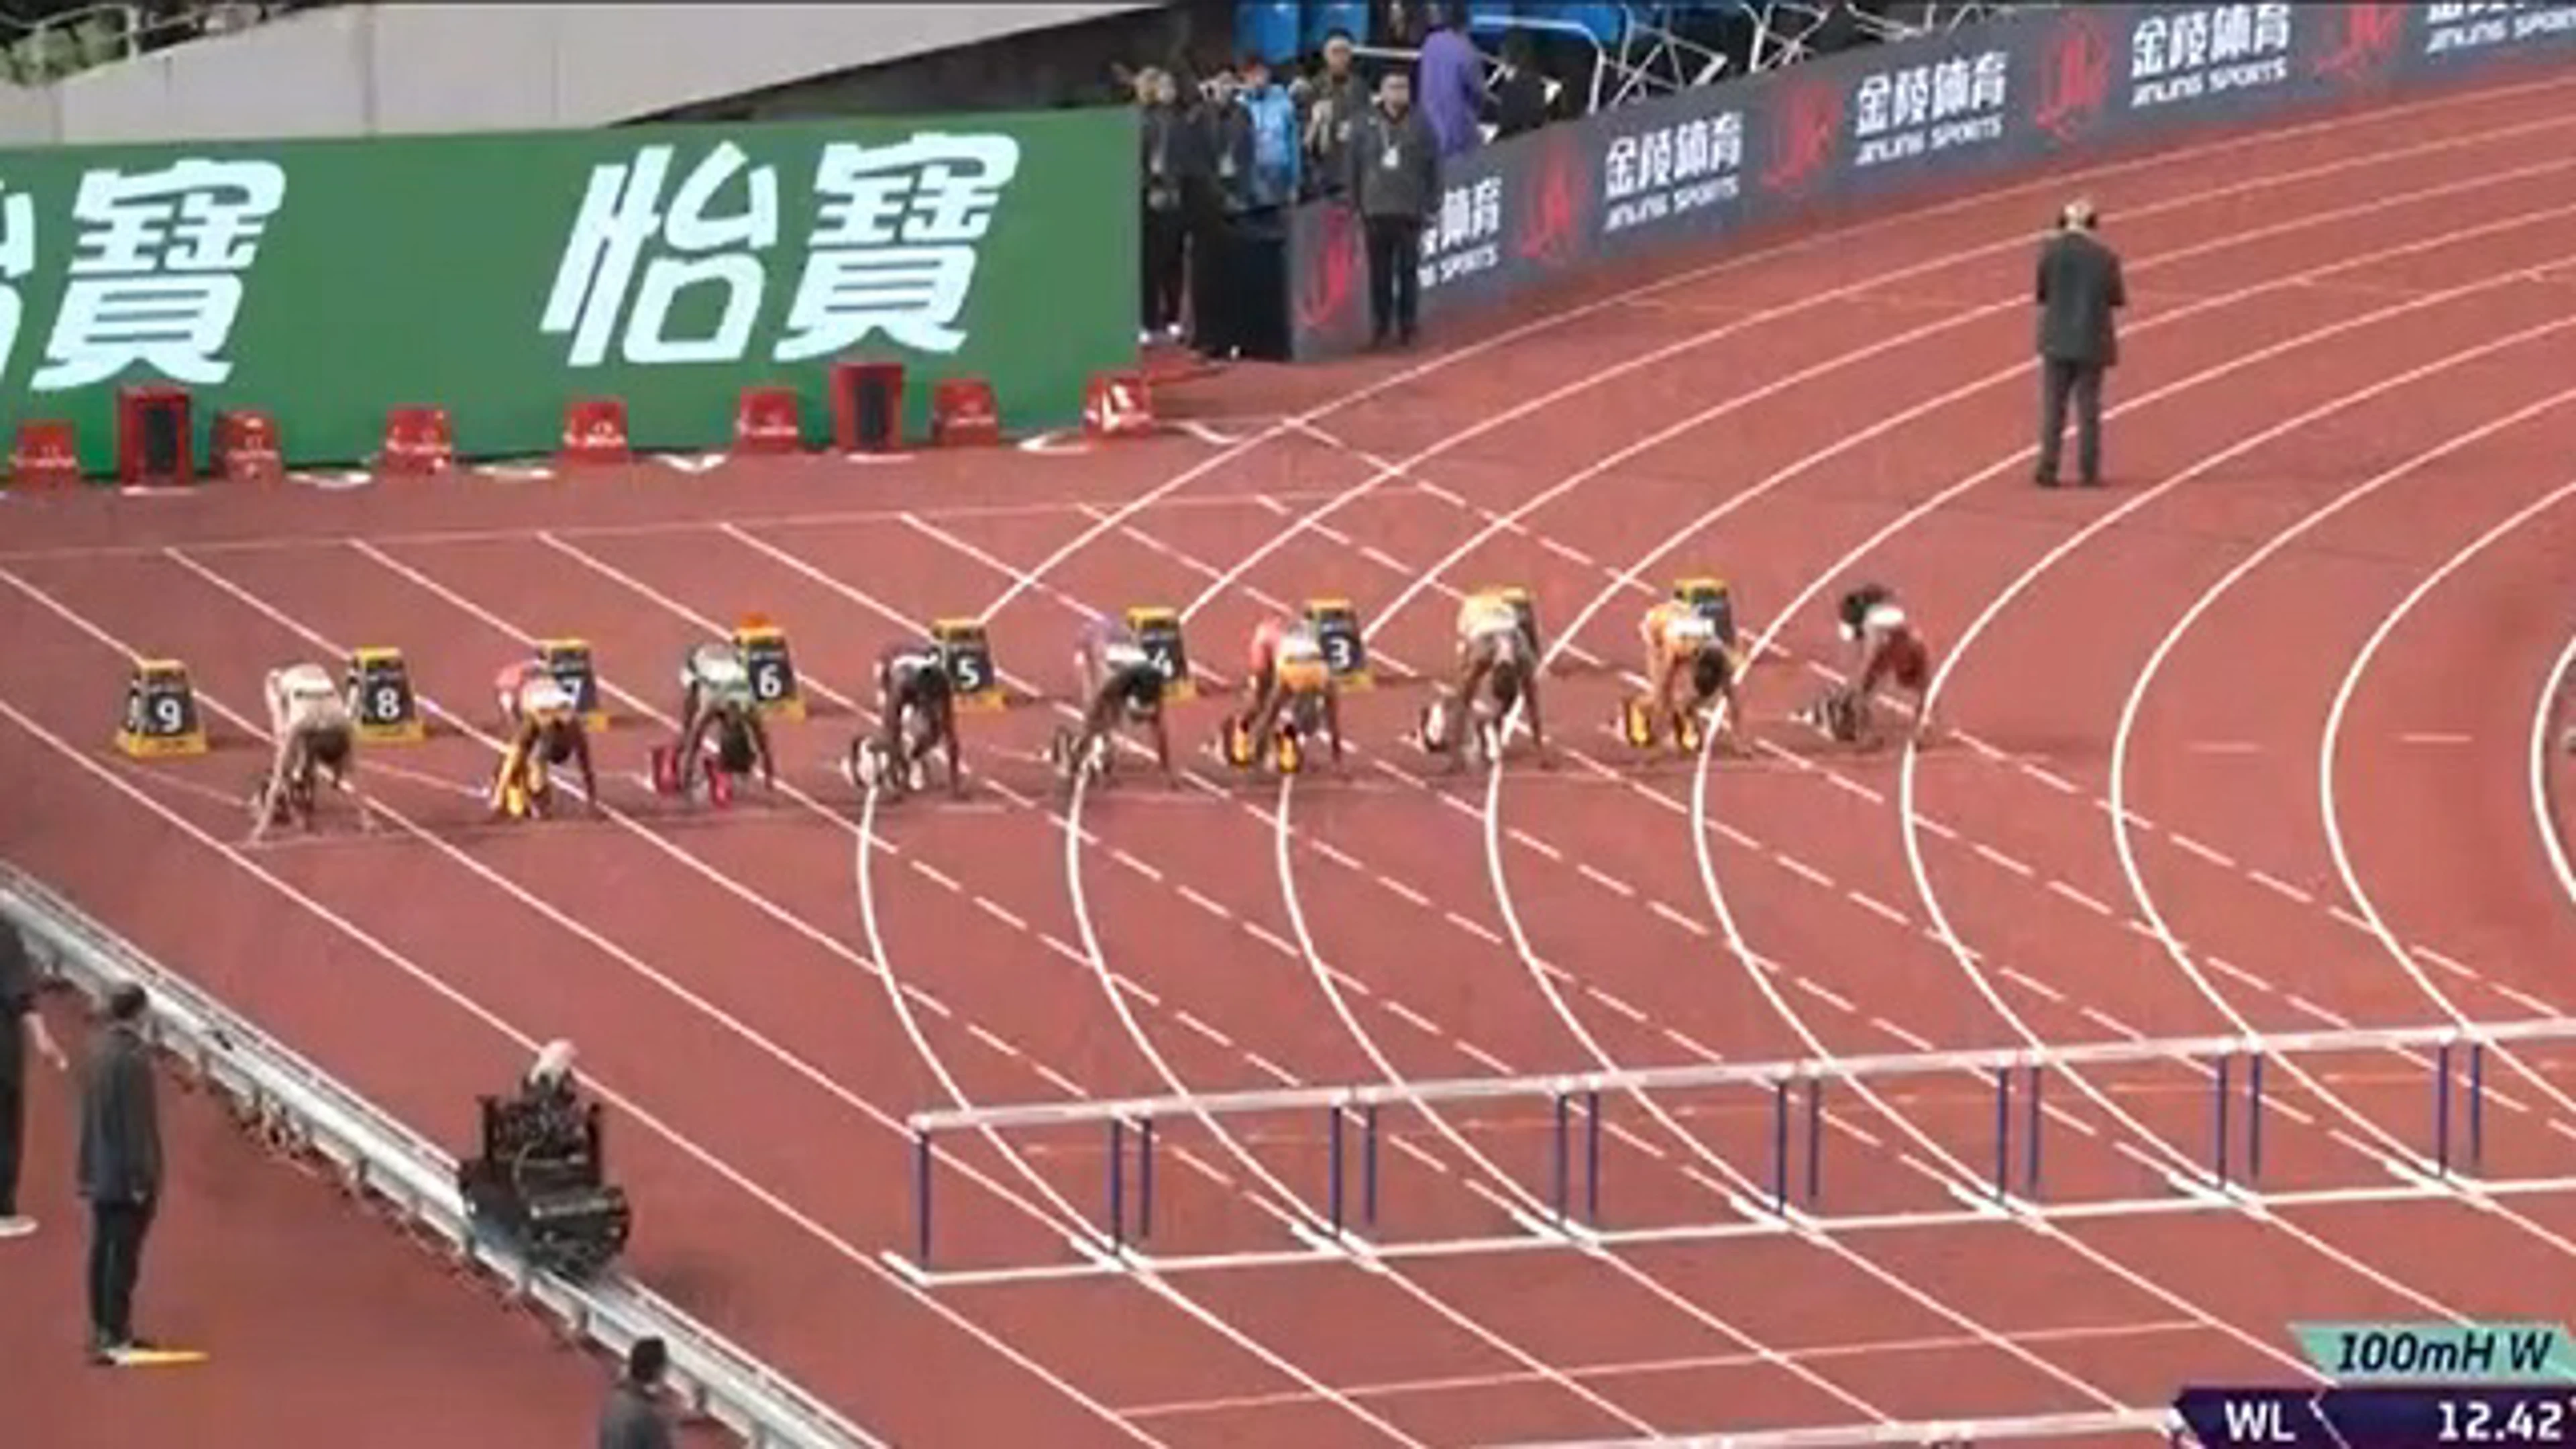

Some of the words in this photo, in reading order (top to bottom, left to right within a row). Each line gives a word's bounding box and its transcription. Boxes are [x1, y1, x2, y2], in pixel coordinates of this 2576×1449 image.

[2209, 56, 2287, 93] SPORTS
[1931, 114, 2004, 150] SPORTS
[540, 131, 1020, 366] 怡寶
[1151, 647, 1173, 678] 4
[1330, 639, 1350, 669] 3
[759, 665, 782, 698] 6
[957, 659, 979, 690] 5
[376, 687, 400, 720] 8
[562, 677, 582, 708] 7
[155, 698, 182, 733] 9
